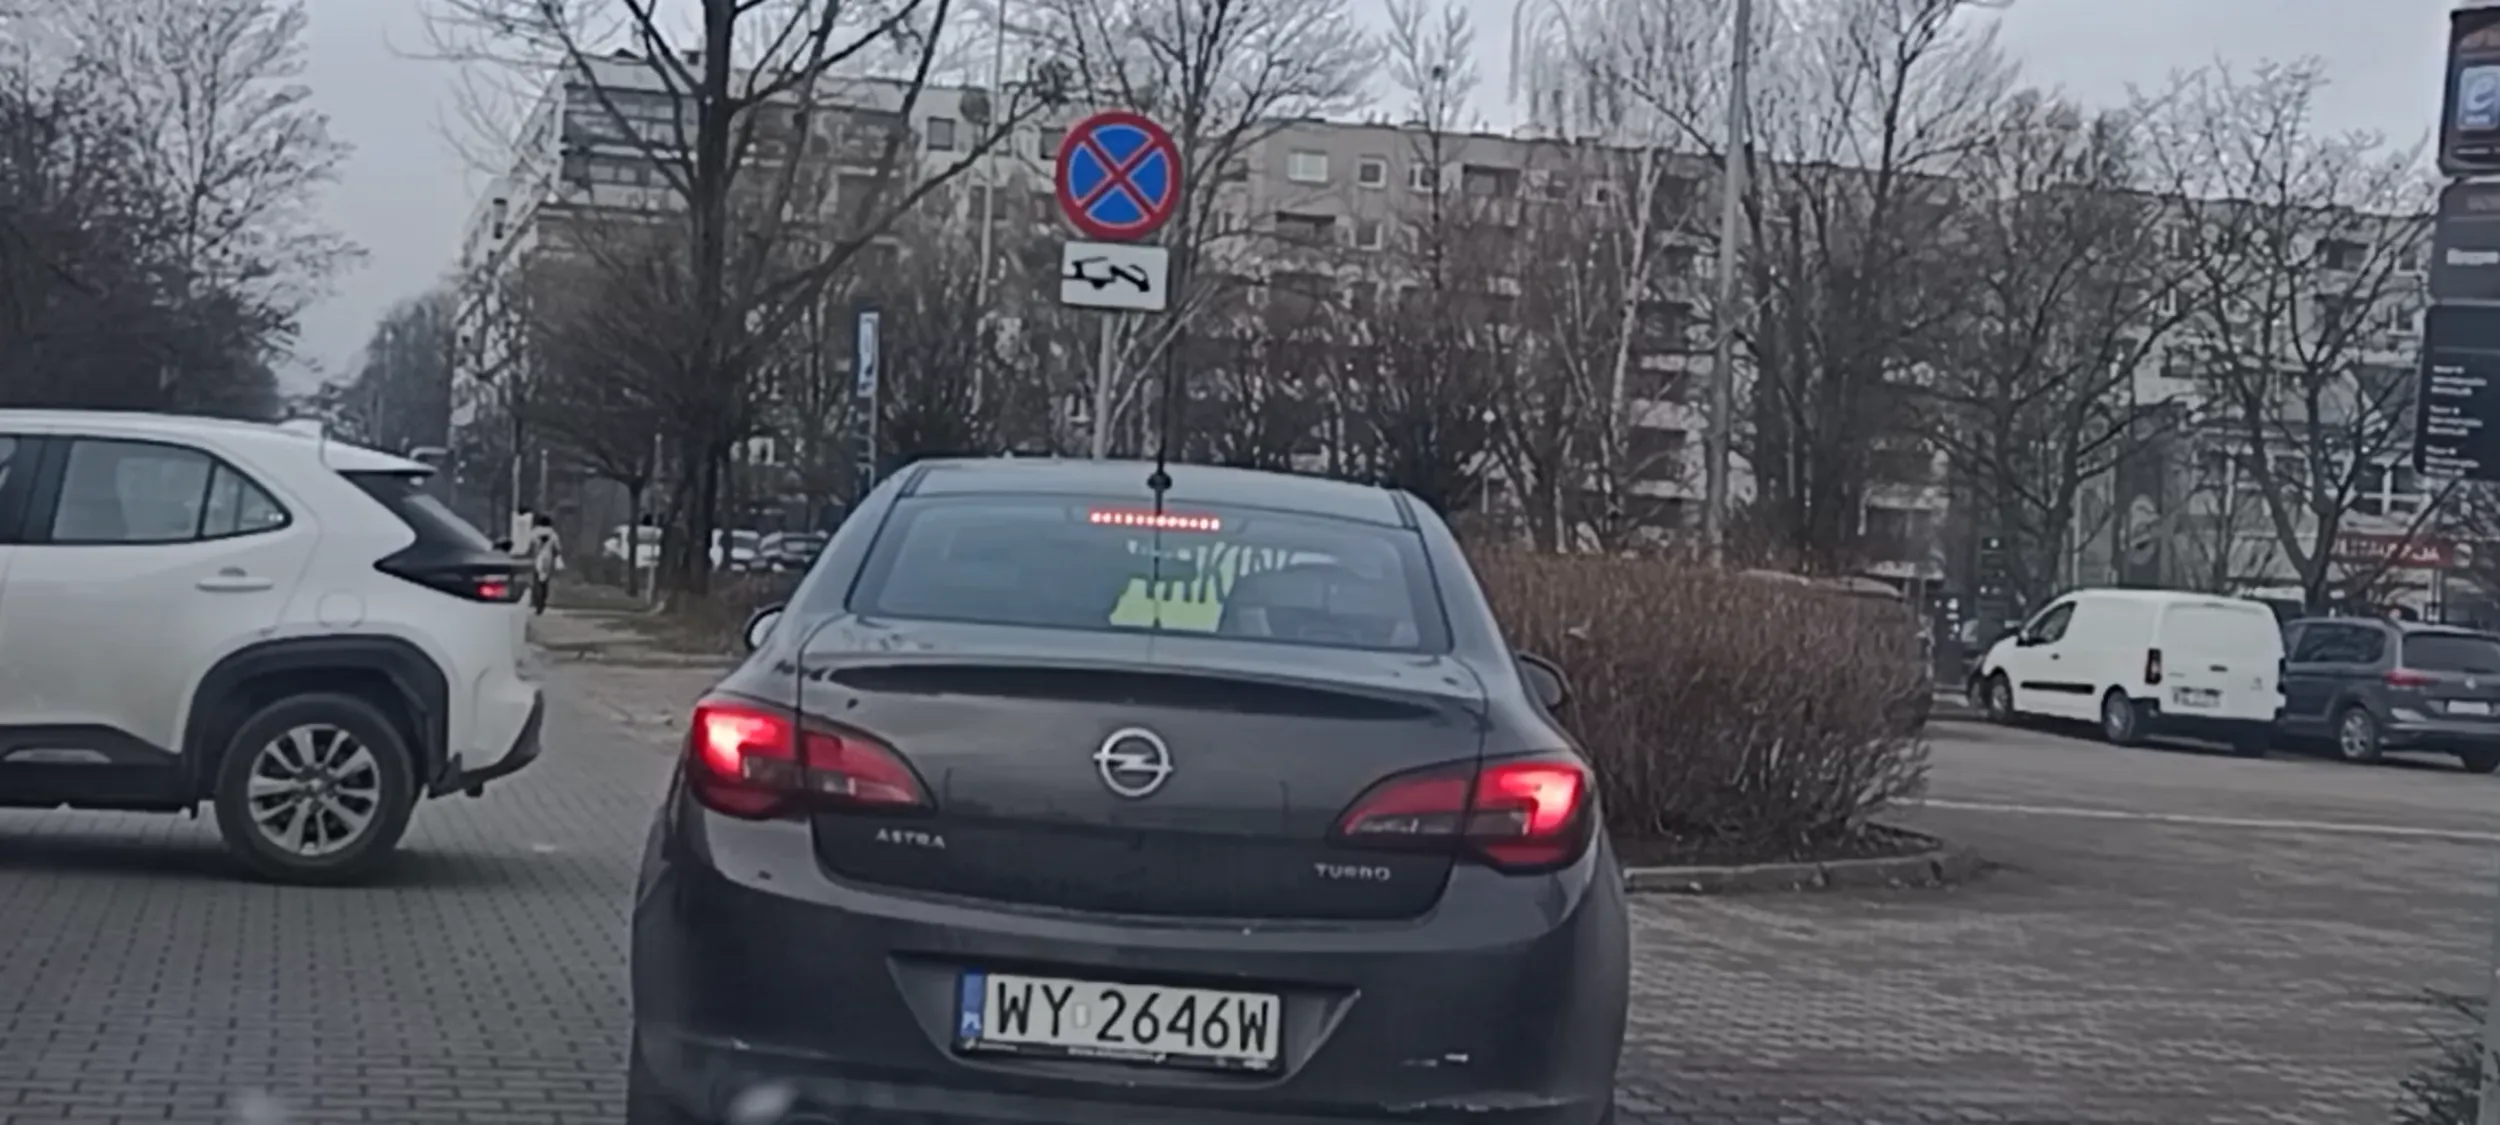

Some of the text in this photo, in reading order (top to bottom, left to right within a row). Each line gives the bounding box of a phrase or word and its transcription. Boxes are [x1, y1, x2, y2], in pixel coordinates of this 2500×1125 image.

[875, 827, 946, 849] ASTRA
[1313, 862, 1391, 881] TURBO
[997, 982, 1269, 1052] WY 2646W
